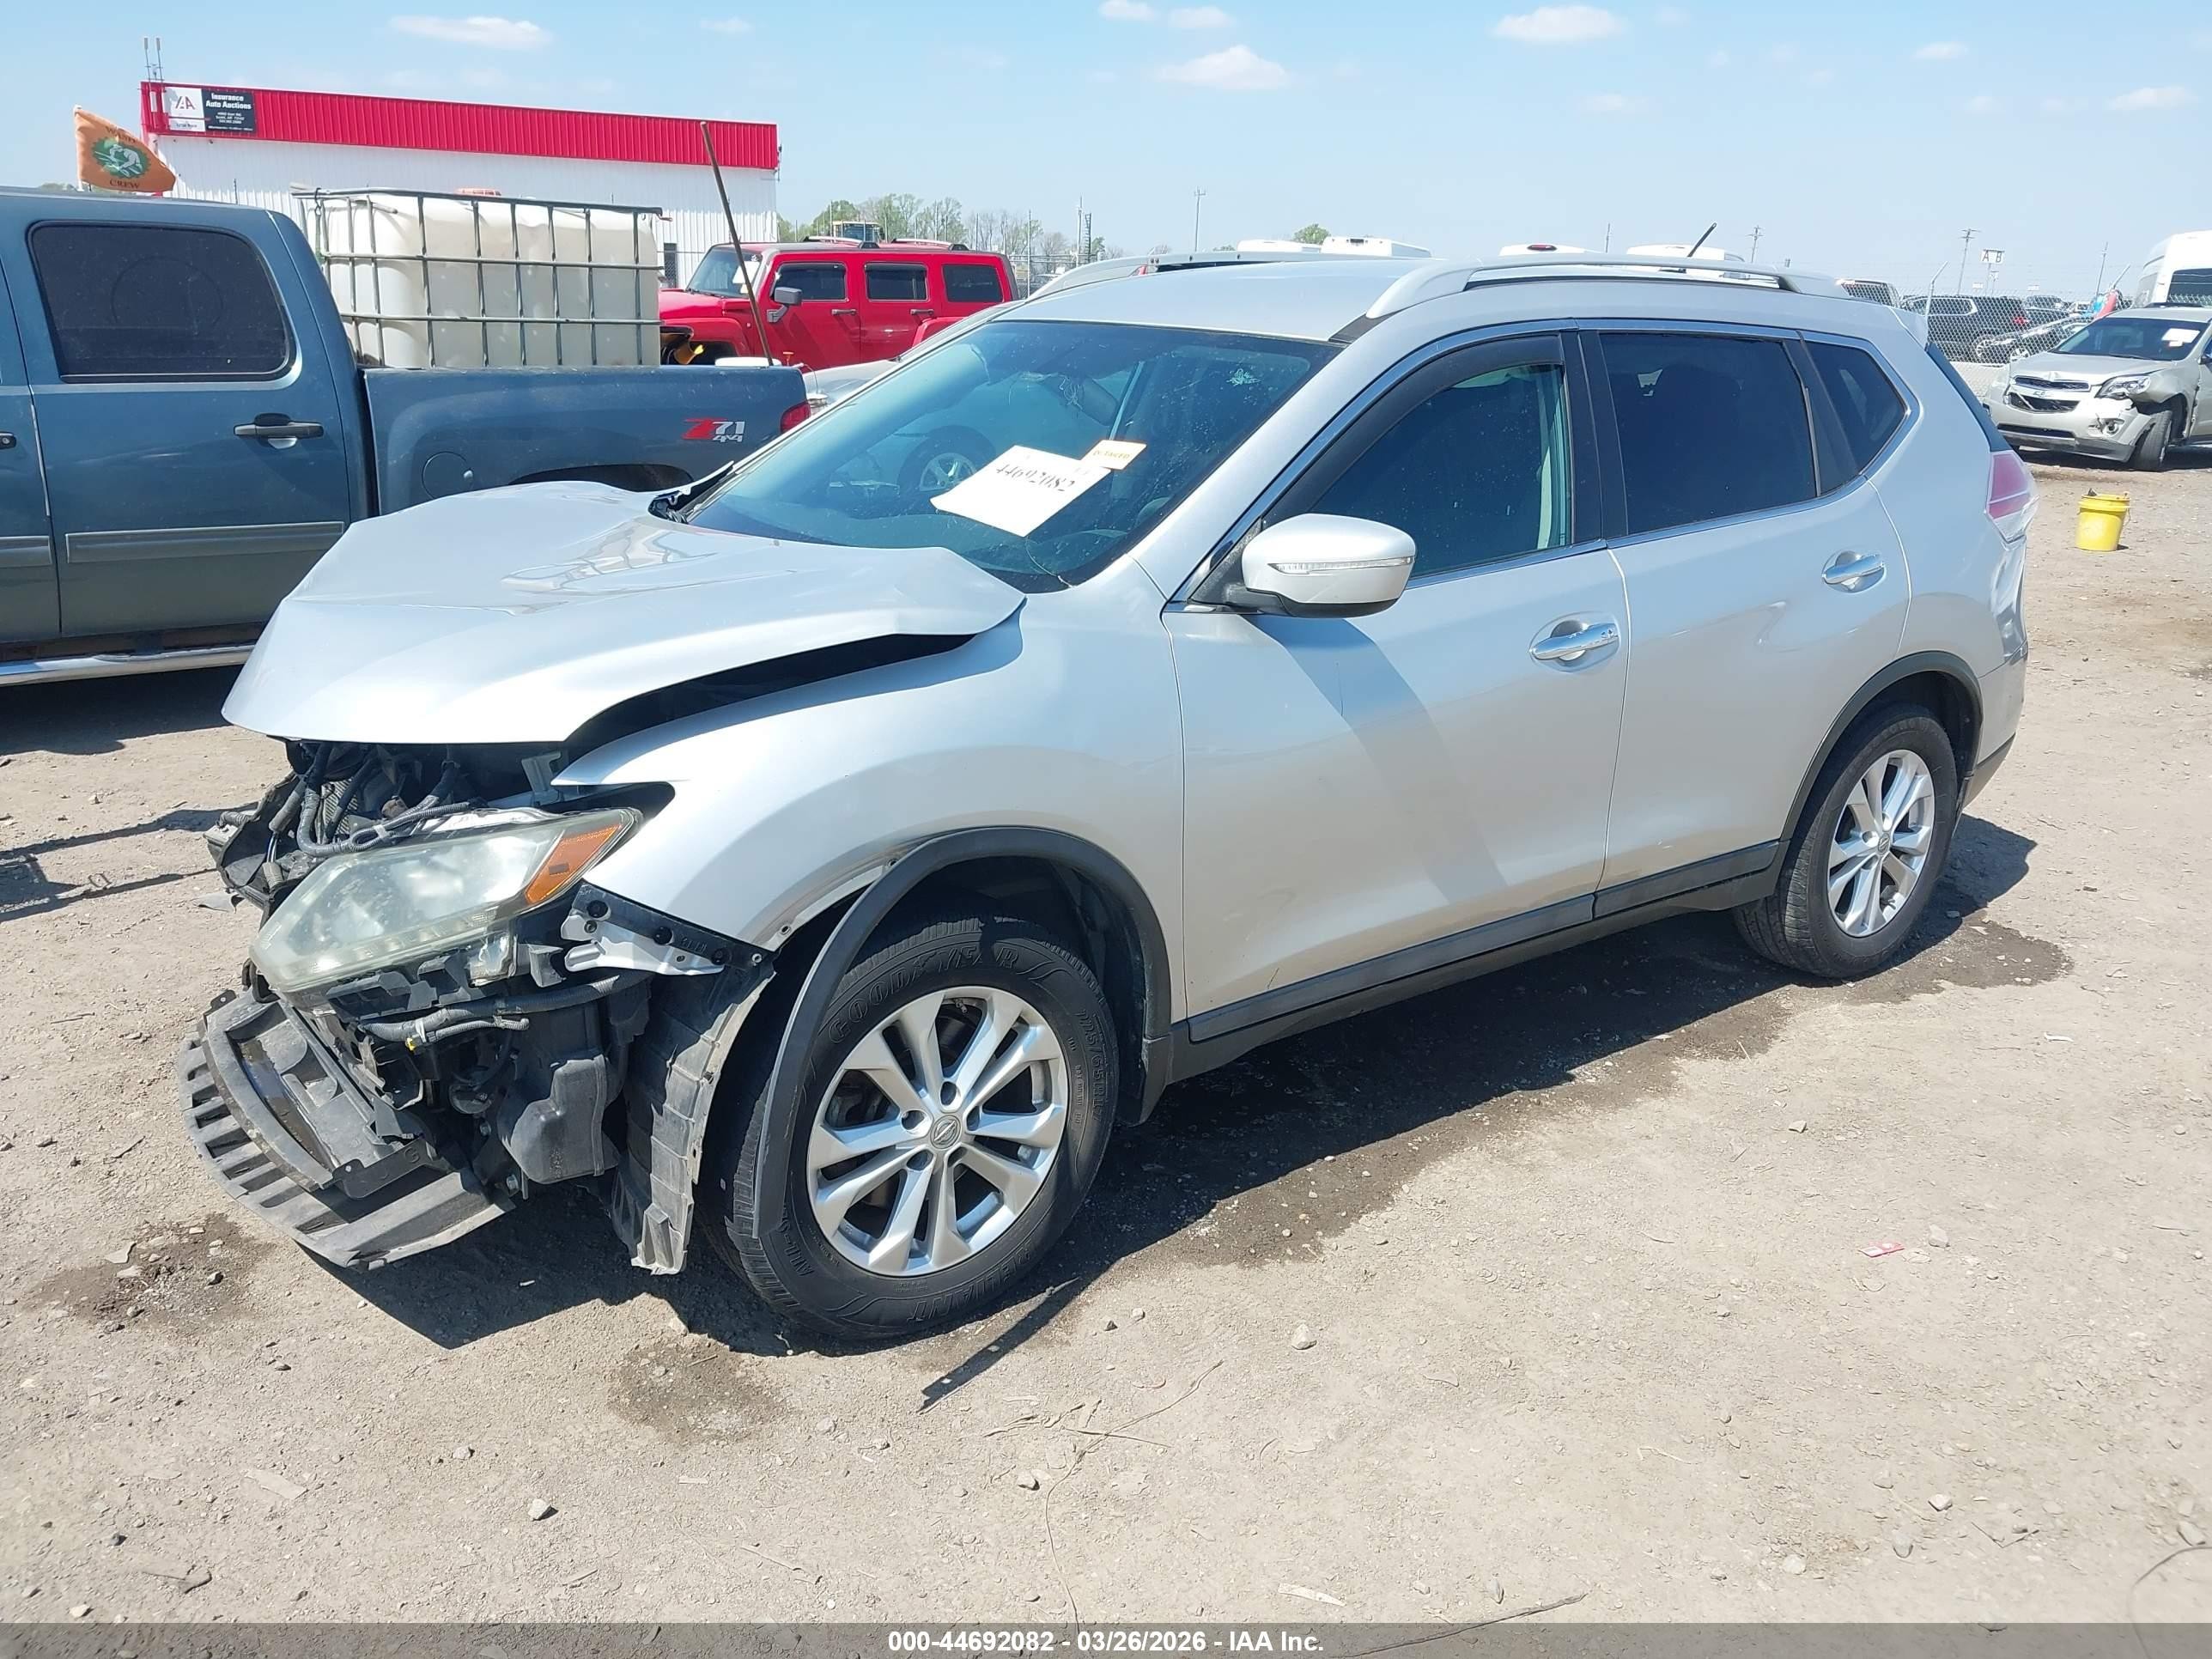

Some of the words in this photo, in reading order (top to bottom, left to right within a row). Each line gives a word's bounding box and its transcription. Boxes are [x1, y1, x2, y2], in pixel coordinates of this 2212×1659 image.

[211, 93, 244, 101] Insurance
[206, 100, 222, 108] Auto
[222, 100, 252, 110] Auctions
[110, 178, 139, 189] CREW
[1982, 250, 1990, 262] A
[1996, 251, 2002, 263] B
[682, 416, 745, 440] Z71
[996, 464, 1076, 492] 44692082
